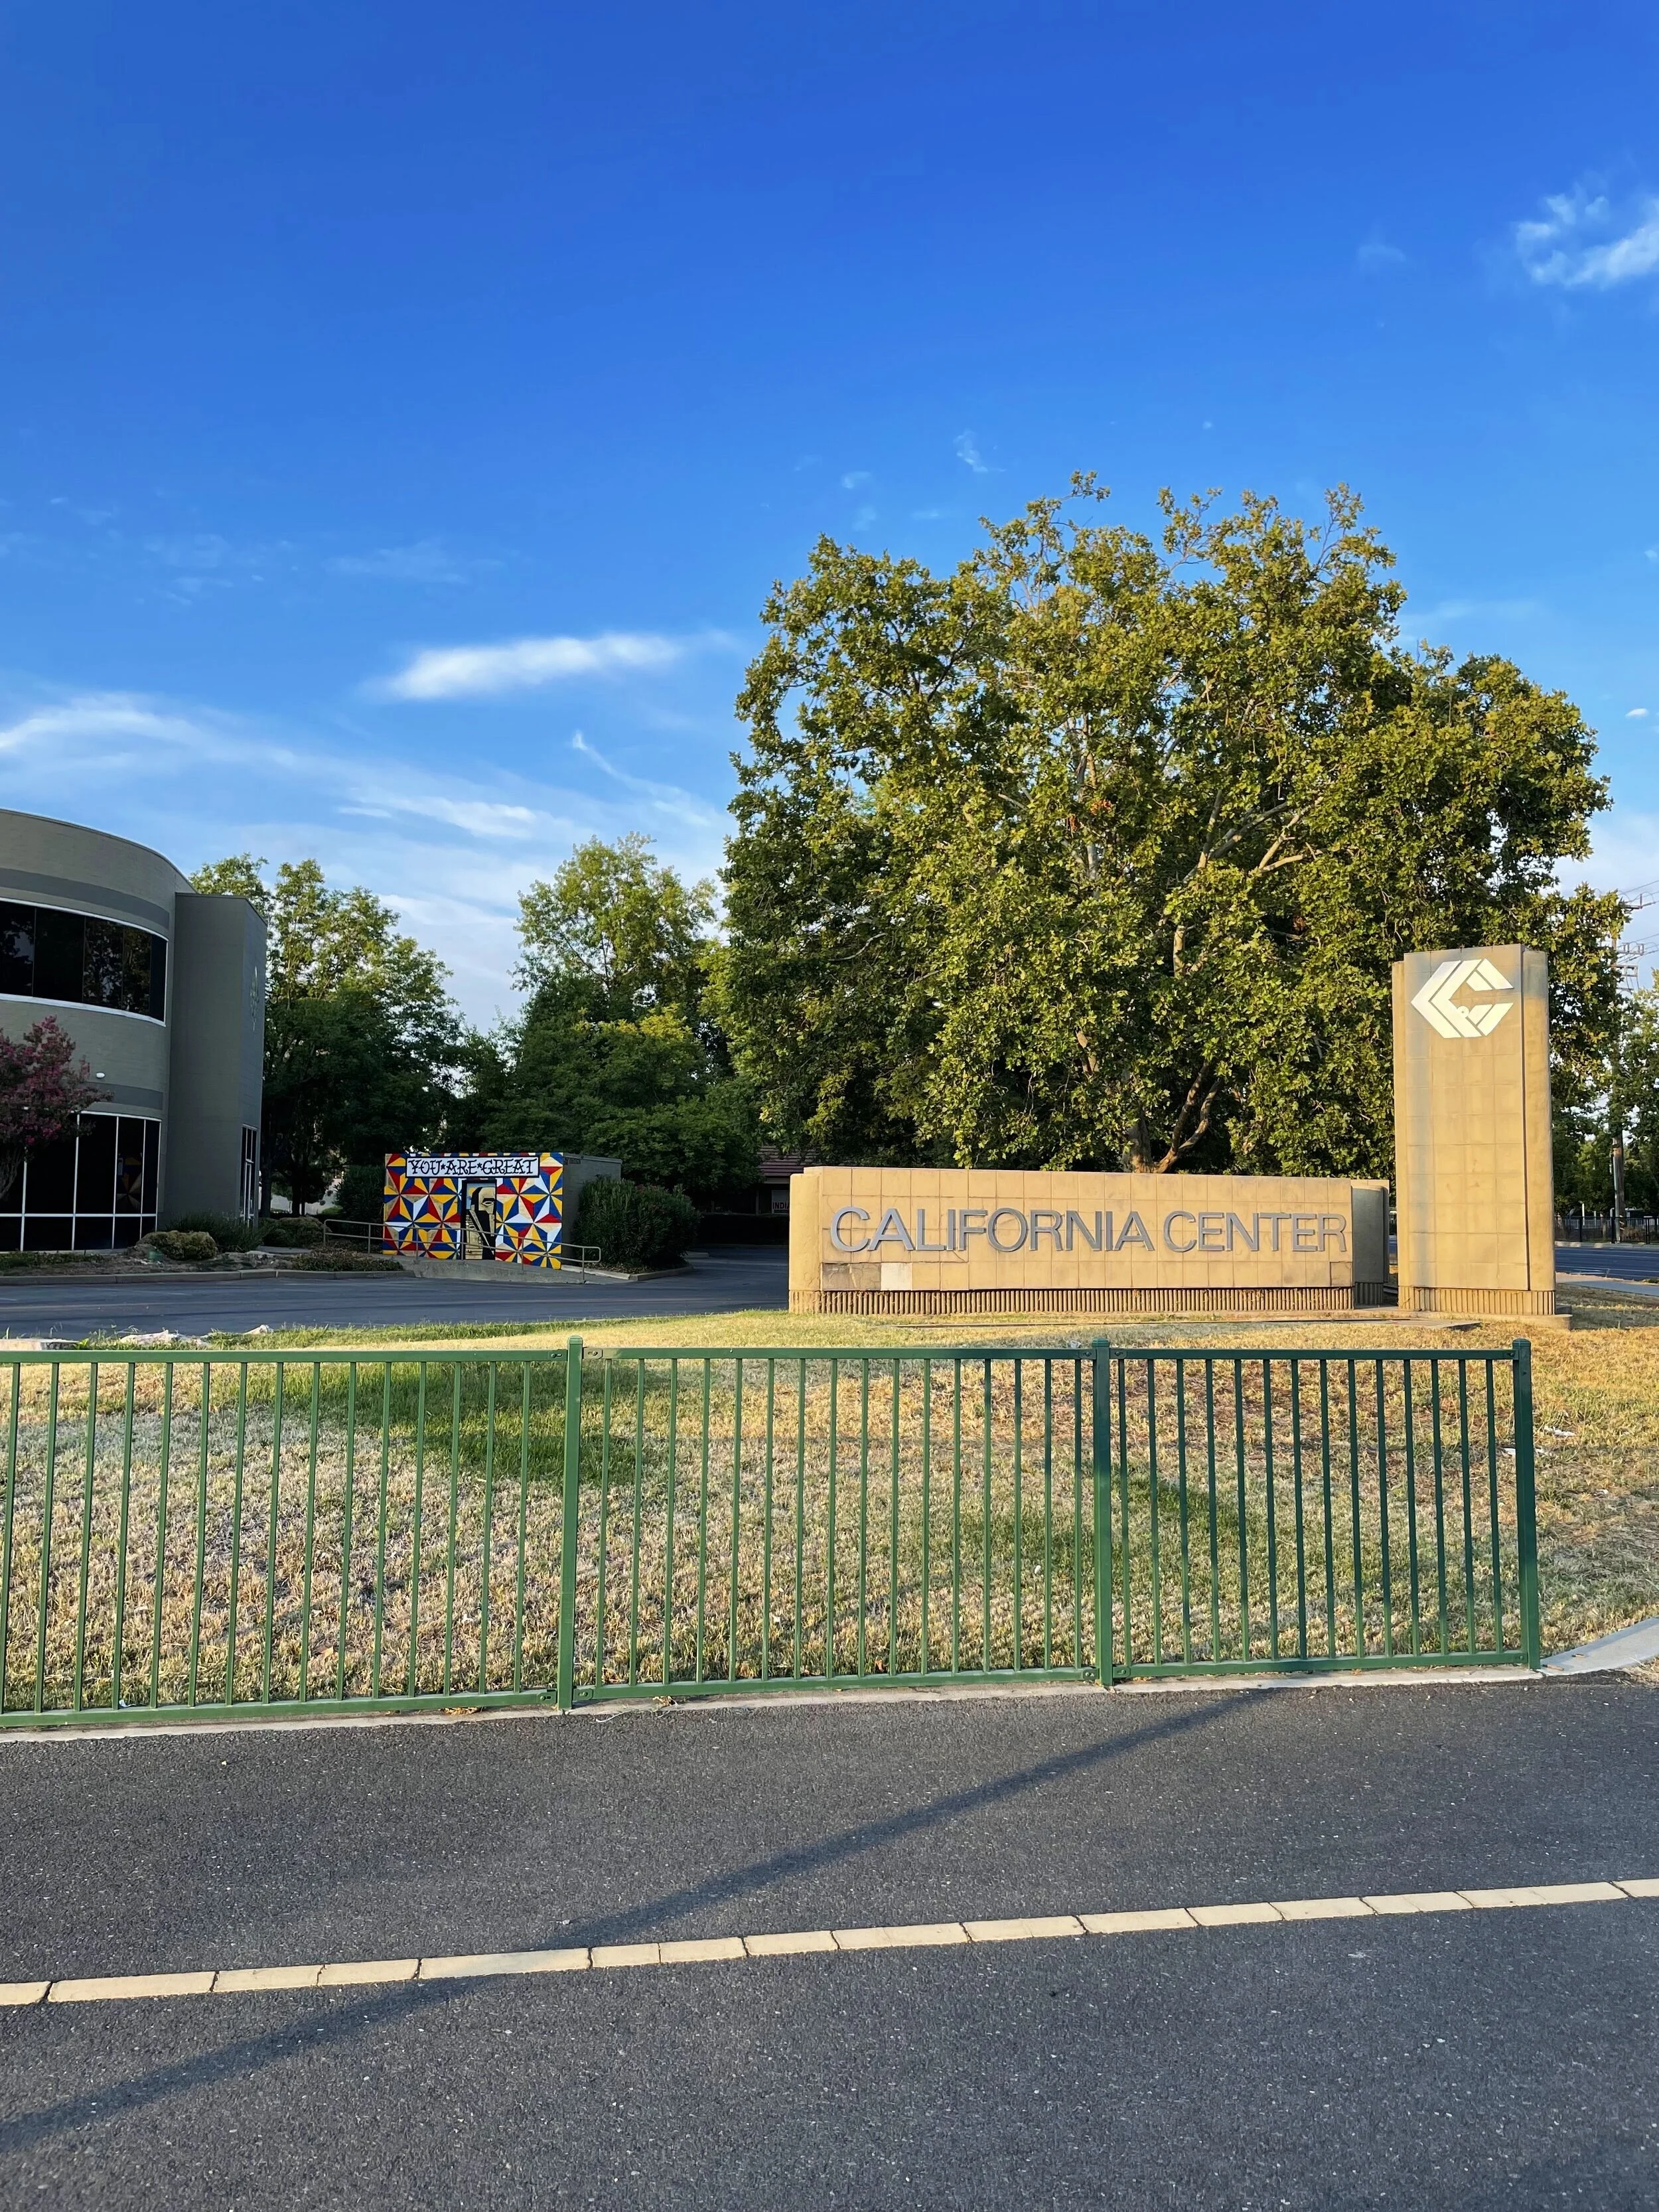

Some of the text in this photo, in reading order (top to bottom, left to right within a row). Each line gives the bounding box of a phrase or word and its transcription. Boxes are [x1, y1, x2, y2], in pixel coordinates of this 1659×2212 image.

[408, 1158, 538, 1175] YOU ARE GREAT
[830, 1206, 1347, 1252] CALIFORNIA CENTER
